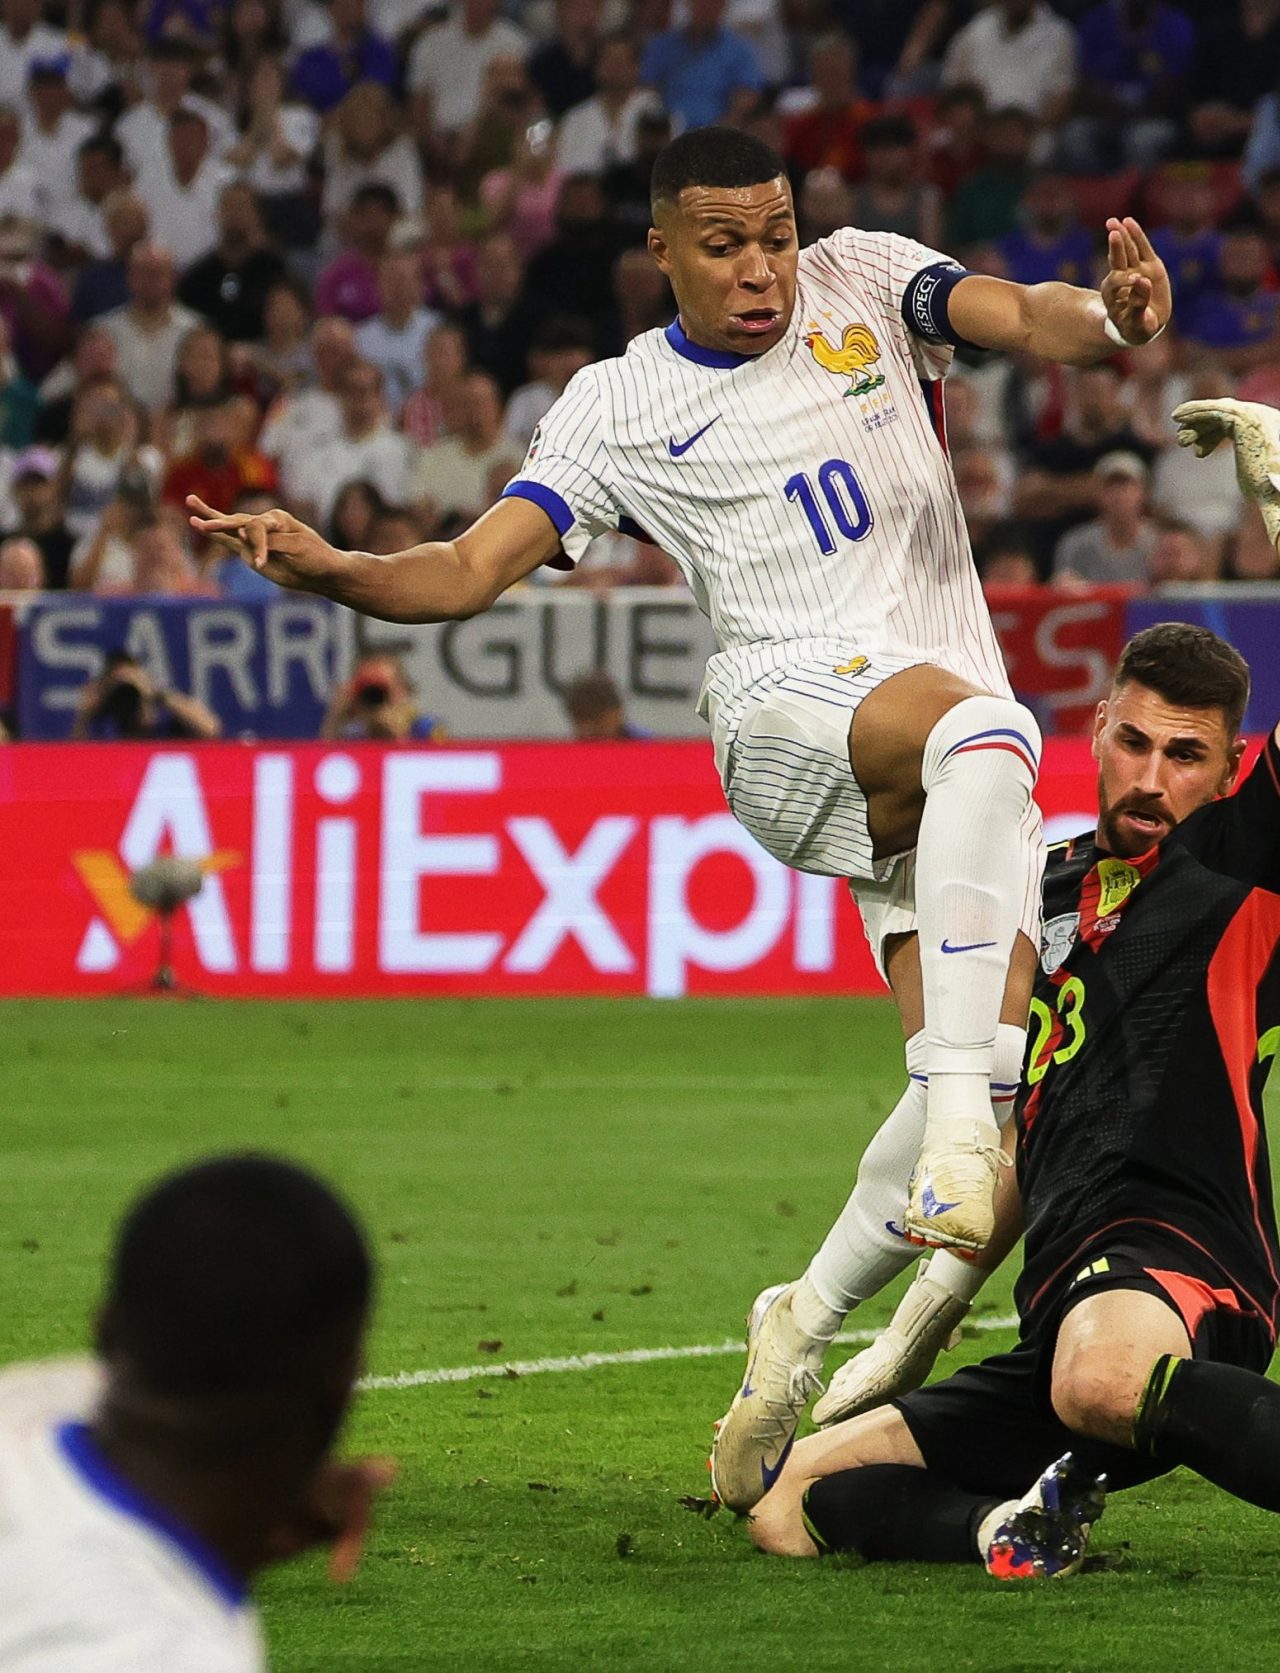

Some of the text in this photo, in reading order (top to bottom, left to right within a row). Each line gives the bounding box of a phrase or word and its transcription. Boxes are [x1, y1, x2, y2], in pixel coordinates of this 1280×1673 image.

[916, 274, 937, 335] RESPECT
[784, 459, 874, 557] 10
[1027, 976, 1086, 1086] 23
